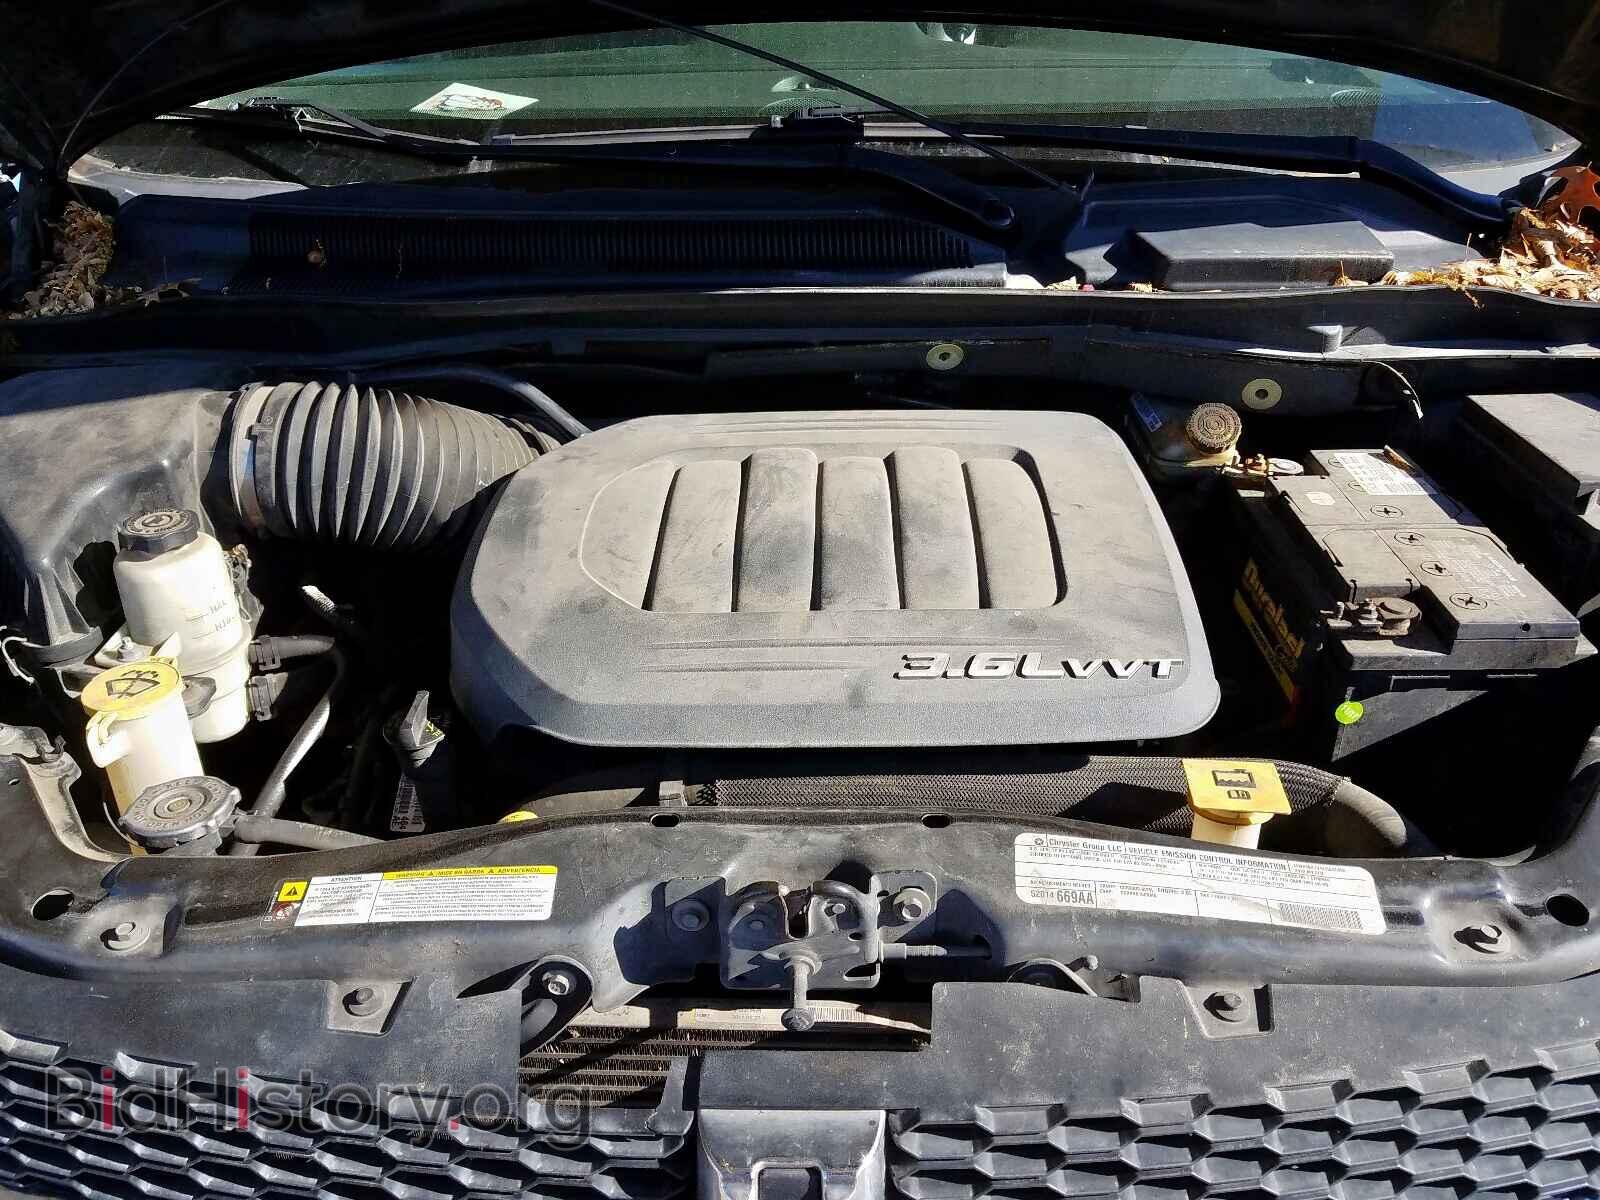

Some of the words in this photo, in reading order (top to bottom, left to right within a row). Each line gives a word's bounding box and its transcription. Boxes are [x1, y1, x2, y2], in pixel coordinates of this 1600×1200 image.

[1082, 841, 1105, 851] Group
[1107, 844, 1122, 852] LLC
[1161, 850, 1197, 860] EMISSION
[1200, 854, 1233, 865] CONTROL
[1235, 858, 1287, 870] INFORMATION
[1057, 890, 1095, 905] 669AA
